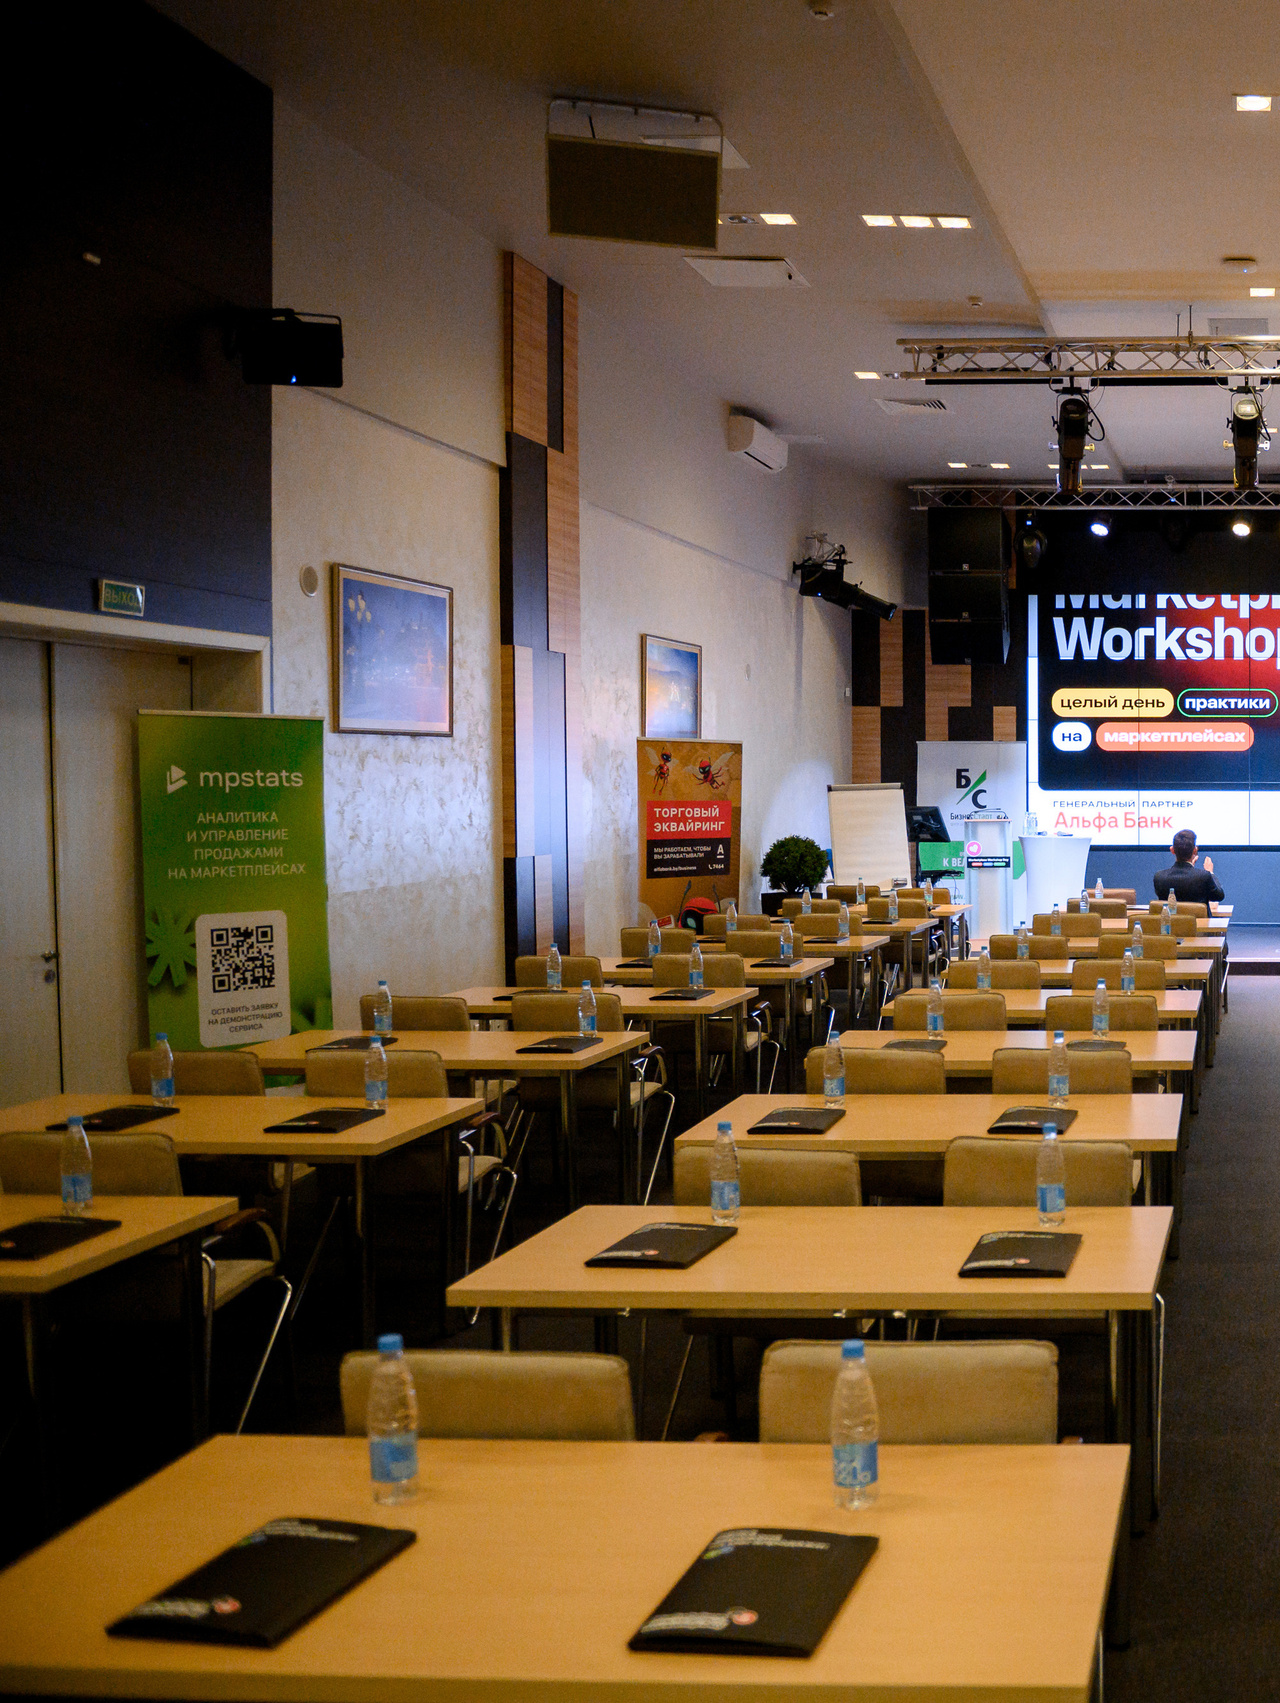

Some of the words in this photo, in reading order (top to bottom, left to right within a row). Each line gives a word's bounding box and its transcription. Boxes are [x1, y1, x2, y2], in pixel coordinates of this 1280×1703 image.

[1061, 695, 1117, 710] целый
[1122, 698, 1165, 710] день
[1184, 697, 1270, 711] практики
[1062, 733, 1082, 742] на
[1104, 729, 1246, 744] маркетплейсах
[200, 769, 303, 793] mpstats
[1053, 800, 1135, 808] ГЕНЕРАЛЬНЫЙ
[197, 811, 278, 824] АНАЛИТИКА
[653, 805, 719, 818] ТОРГОВЫЙ
[653, 820, 725, 833] ЭКВАЙРИНГ
[1054, 811, 1118, 832] Альфа
[1124, 812, 1173, 829] Банк
[187, 831, 197, 842] И
[200, 829, 288, 842] УПРАВЛЕНИЕ
[194, 847, 283, 861] ПРОДАЖАМИ
[943, 858, 949, 866] К
[168, 868, 187, 879] НА
[191, 862, 306, 878] МАРКЕТПЛЕЙСАХ
[211, 1006, 250, 1016] ОСТАВИТЬ
[251, 1002, 279, 1011] ЗАЯВКУ
[220, 1011, 283, 1025] ДЕМОНСТРАЦИЮ
[229, 1023, 263, 1033] СЕРВИСА
